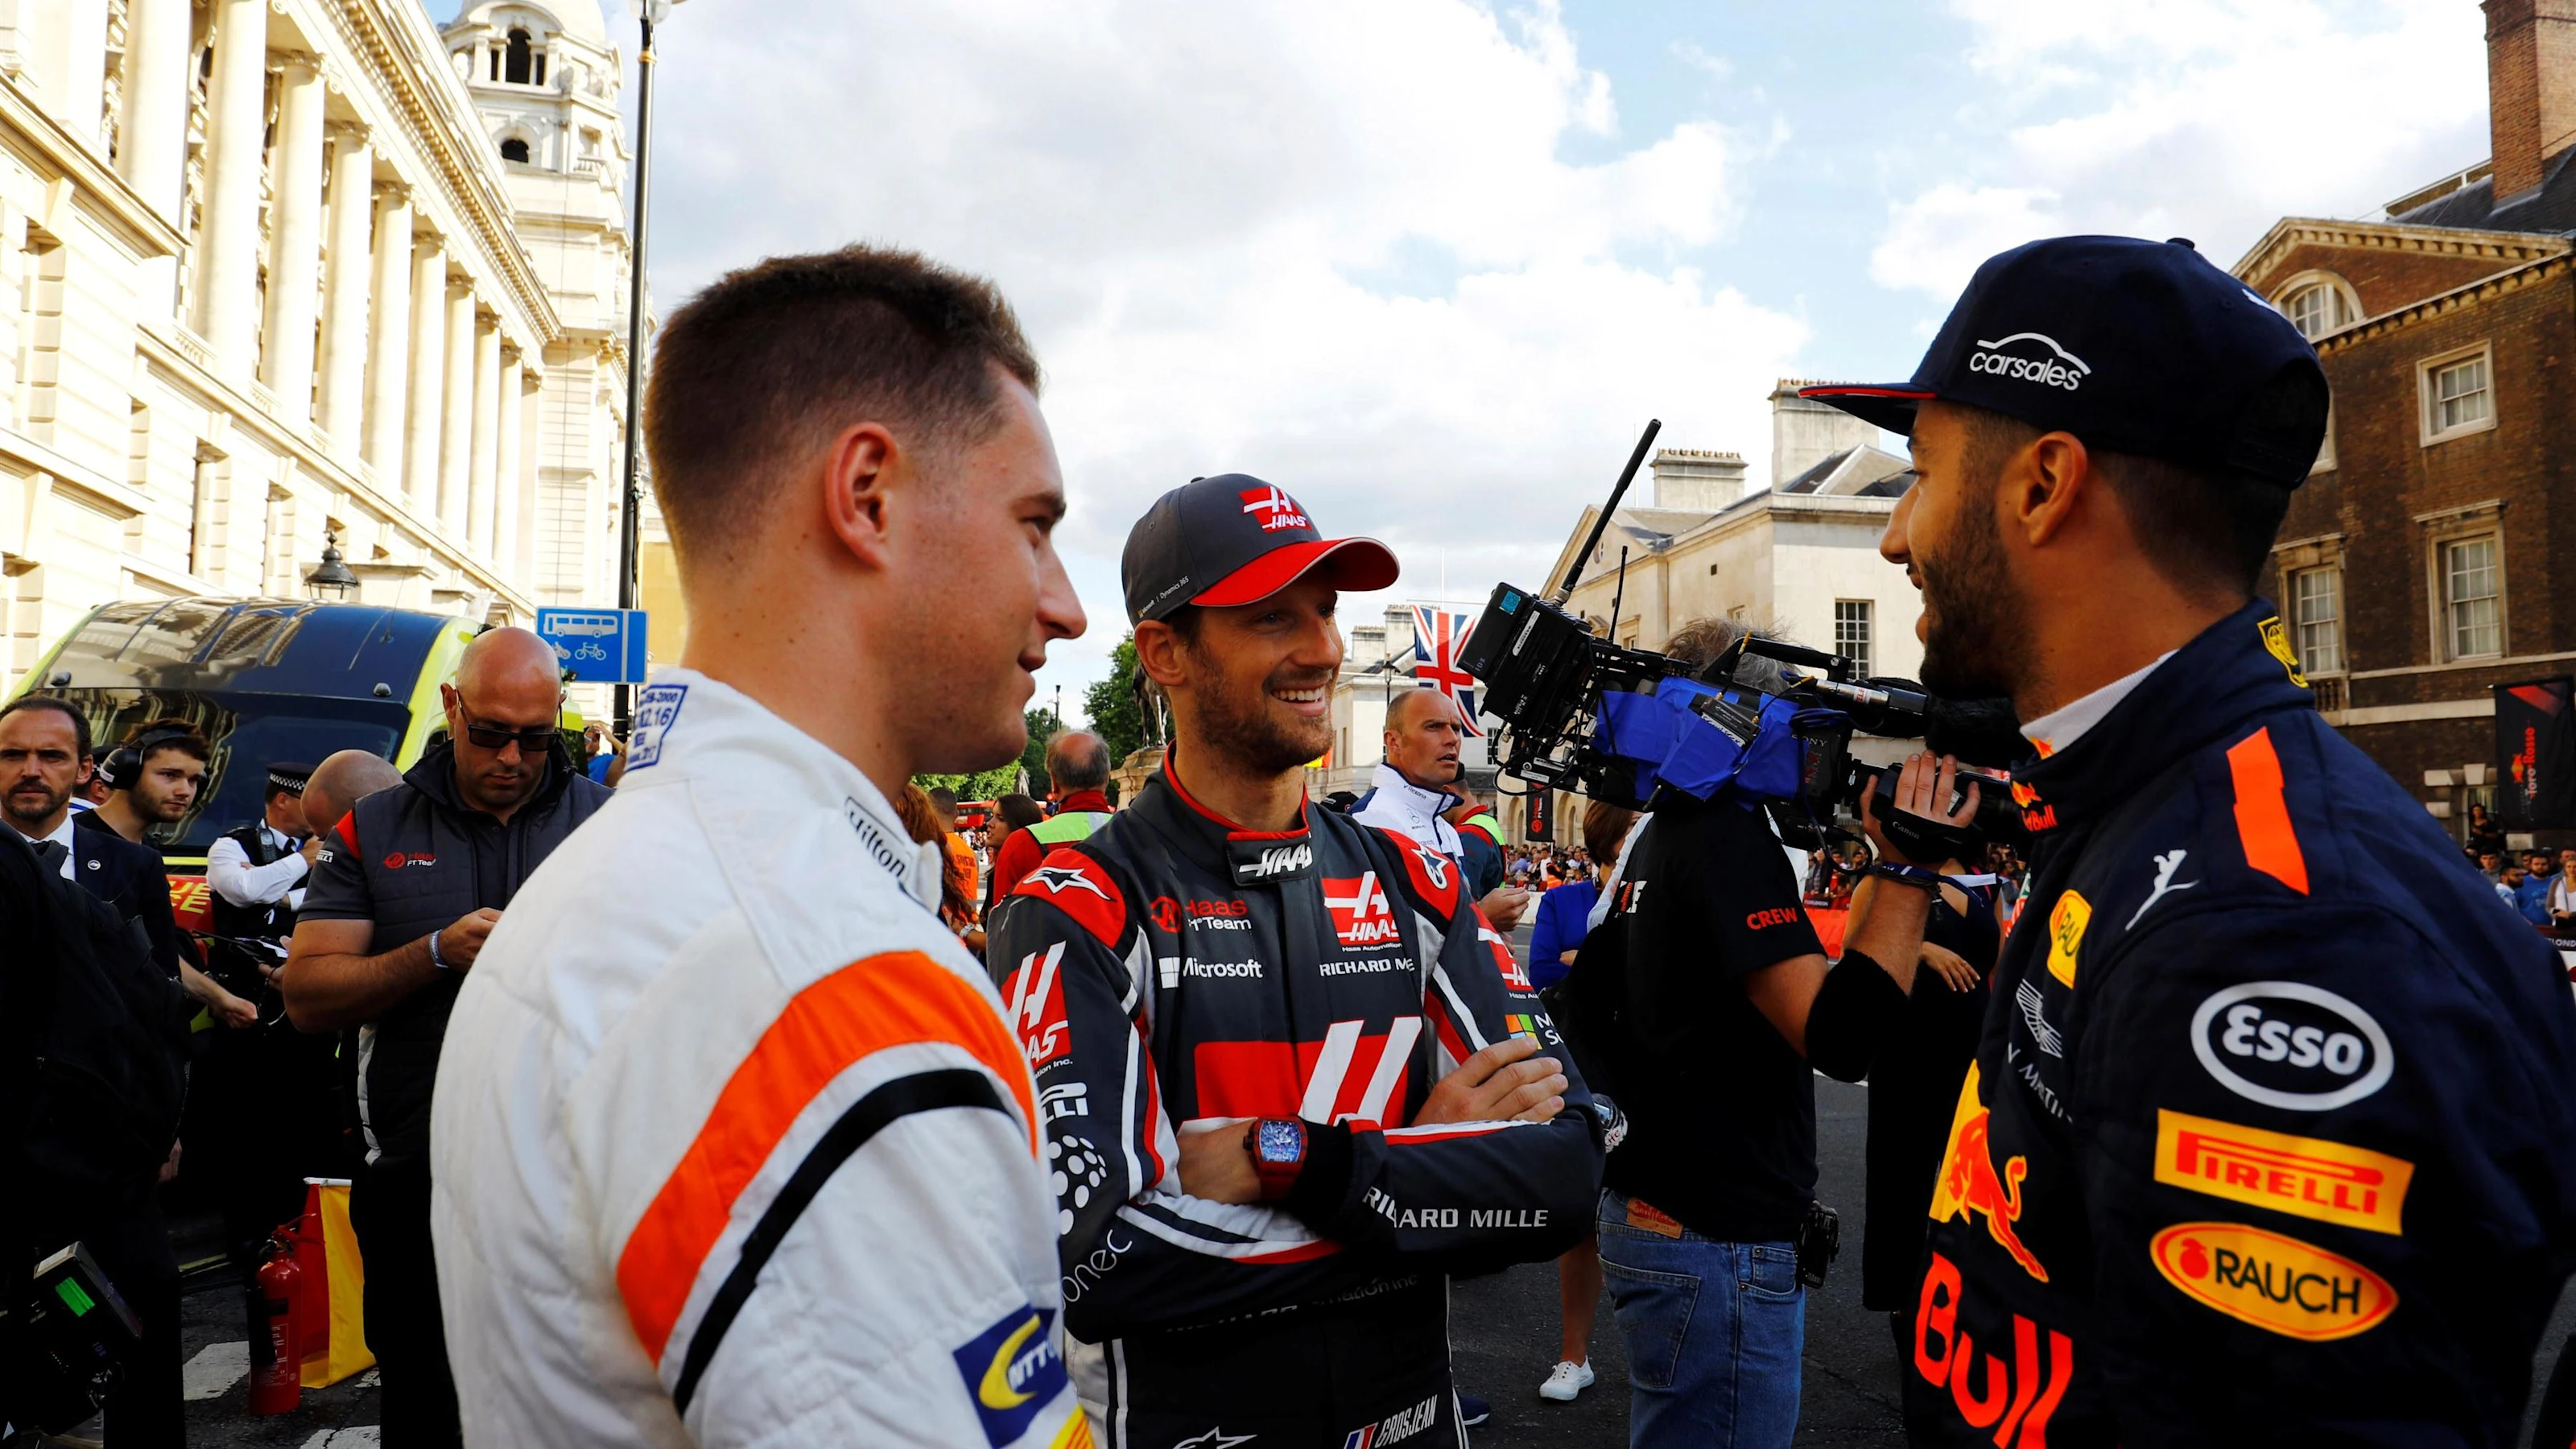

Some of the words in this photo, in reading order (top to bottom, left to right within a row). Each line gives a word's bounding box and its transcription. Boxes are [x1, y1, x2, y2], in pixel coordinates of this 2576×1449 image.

[1969, 352, 2083, 391] carsales
[1261, 513, 1307, 530] HAAS
[1159, 583, 1180, 599] Dynamics
[1179, 576, 1190, 587] 365
[2522, 727, 2536, 764] Rosso
[1892, 821, 1920, 840] Canon
[1202, 916, 1252, 931] Team
[1747, 907, 1798, 930] CREW
[1319, 959, 1392, 977] RICHARD
[2222, 1005, 2364, 1076] Esso
[1053, 1059, 1073, 1071] Inc.
[2176, 1129, 2384, 1215] PIRELLI
[1470, 1209, 1549, 1228] MILLE
[1061, 1228, 1133, 1311] onec
[2215, 1247, 2361, 1315] RAUCH
[1914, 1251, 2074, 1449] Bull
[1374, 1394, 1438, 1447] GROSJEAN
